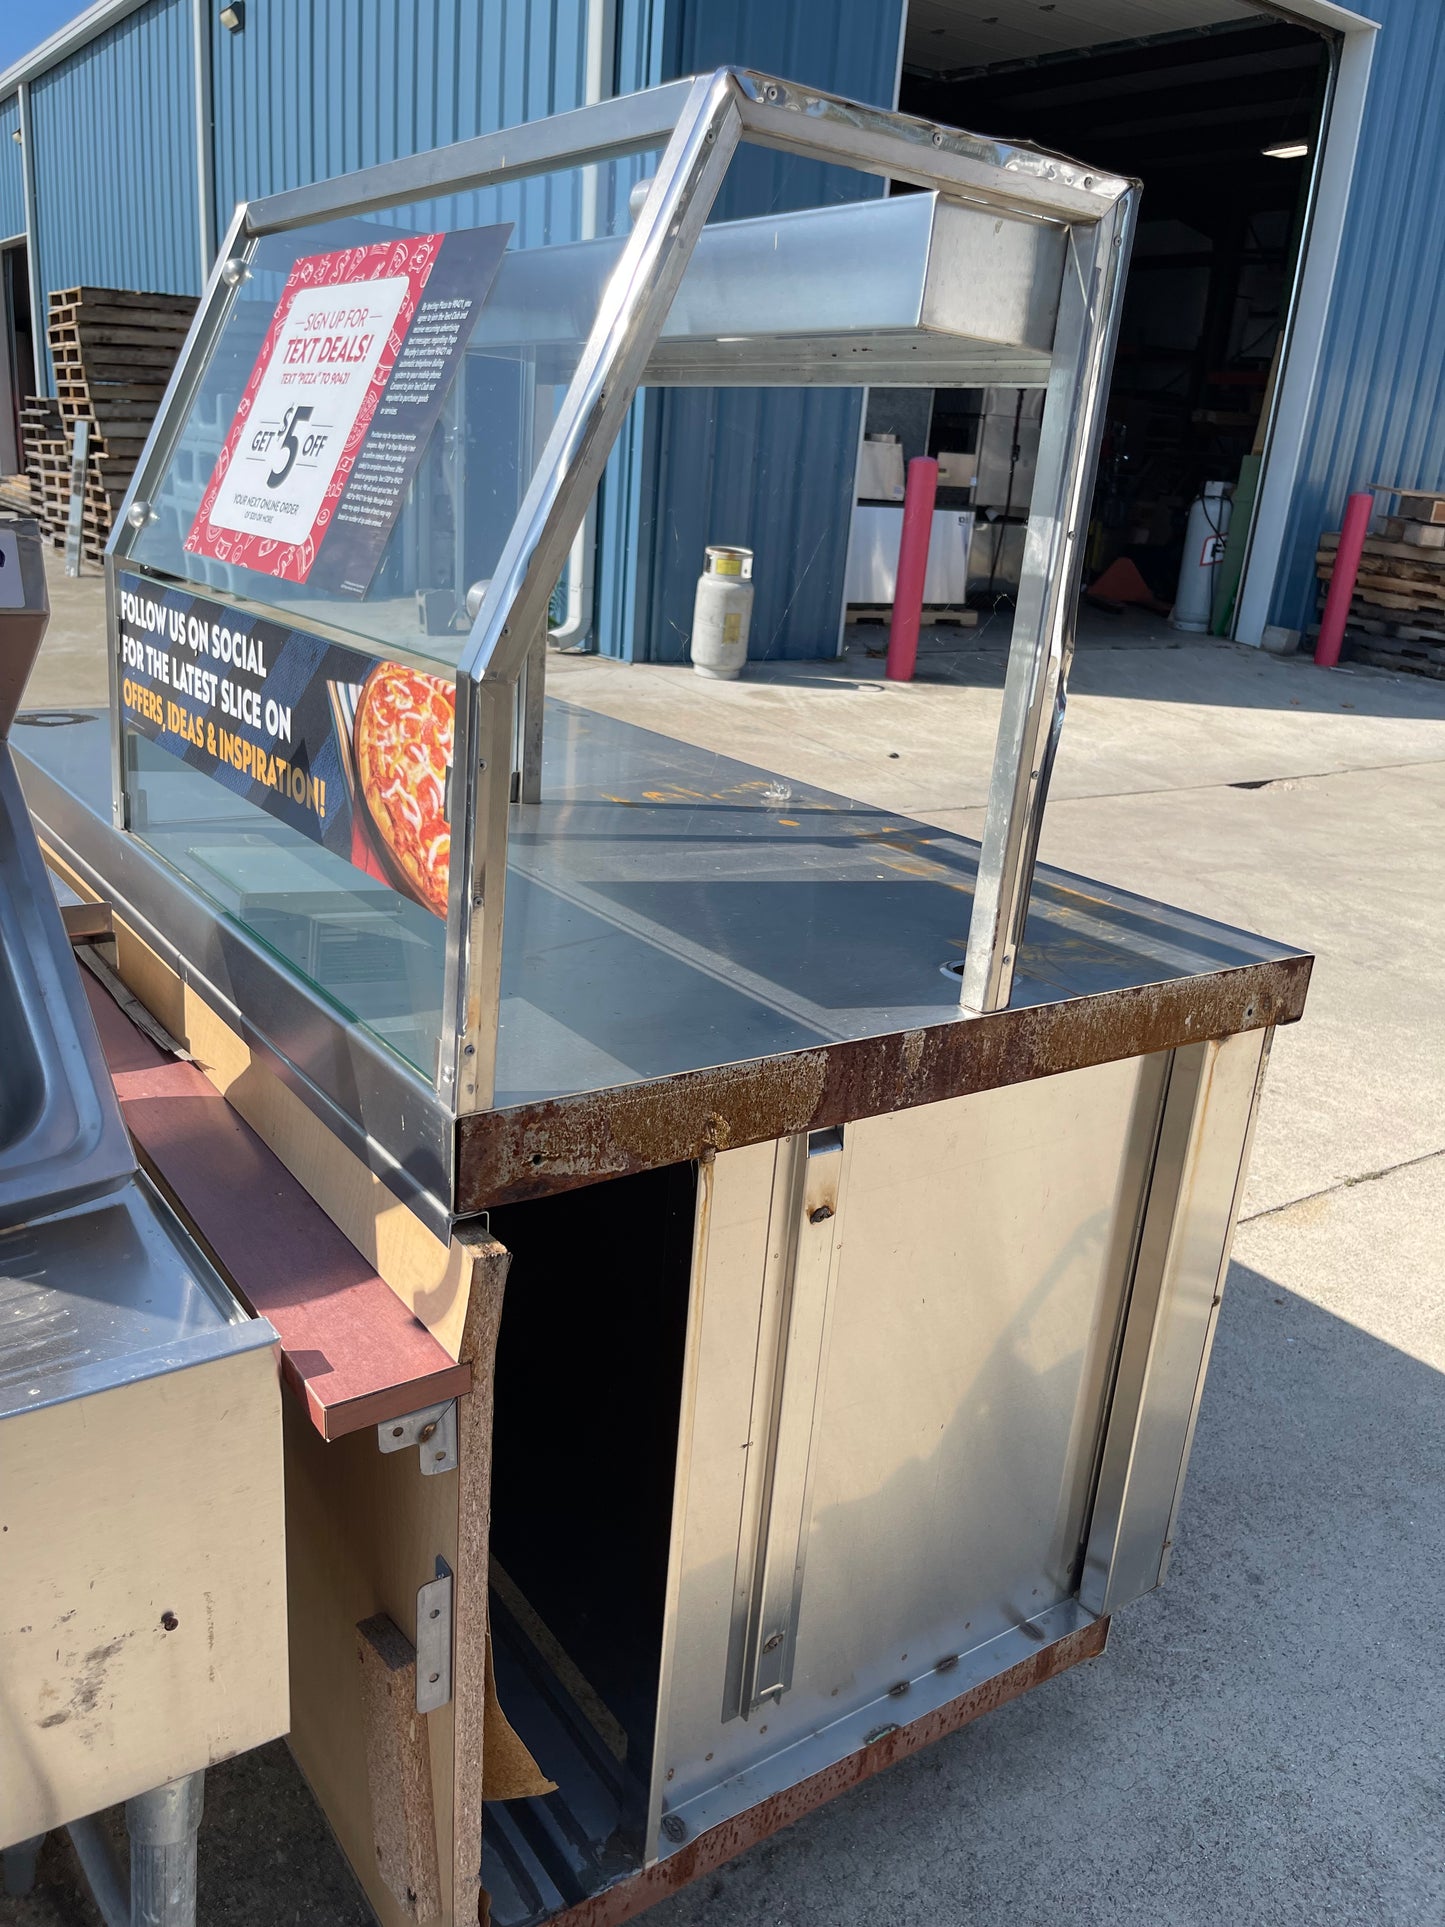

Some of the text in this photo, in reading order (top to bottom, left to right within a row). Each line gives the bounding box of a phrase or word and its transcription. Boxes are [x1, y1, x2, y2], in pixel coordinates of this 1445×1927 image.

[304, 309, 369, 330] SIGN UP FOR
[283, 334, 374, 363] TEXT DEALS!
[281, 373, 297, 384] TEXT
[320, 373, 331, 384] TO
[330, 373, 350, 384] 90421
[251, 431, 275, 452] GET
[302, 434, 328, 457] OFF
[233, 493, 299, 515] YOUR NEXT ONLINE ORDER
[121, 591, 267, 677] FOLLOW US ON SOCIAL
[123, 635, 292, 743] FOR THE LATEST SLICE ON
[123, 680, 326, 818] OFFERS, IDEAS & INSPIRATION!
